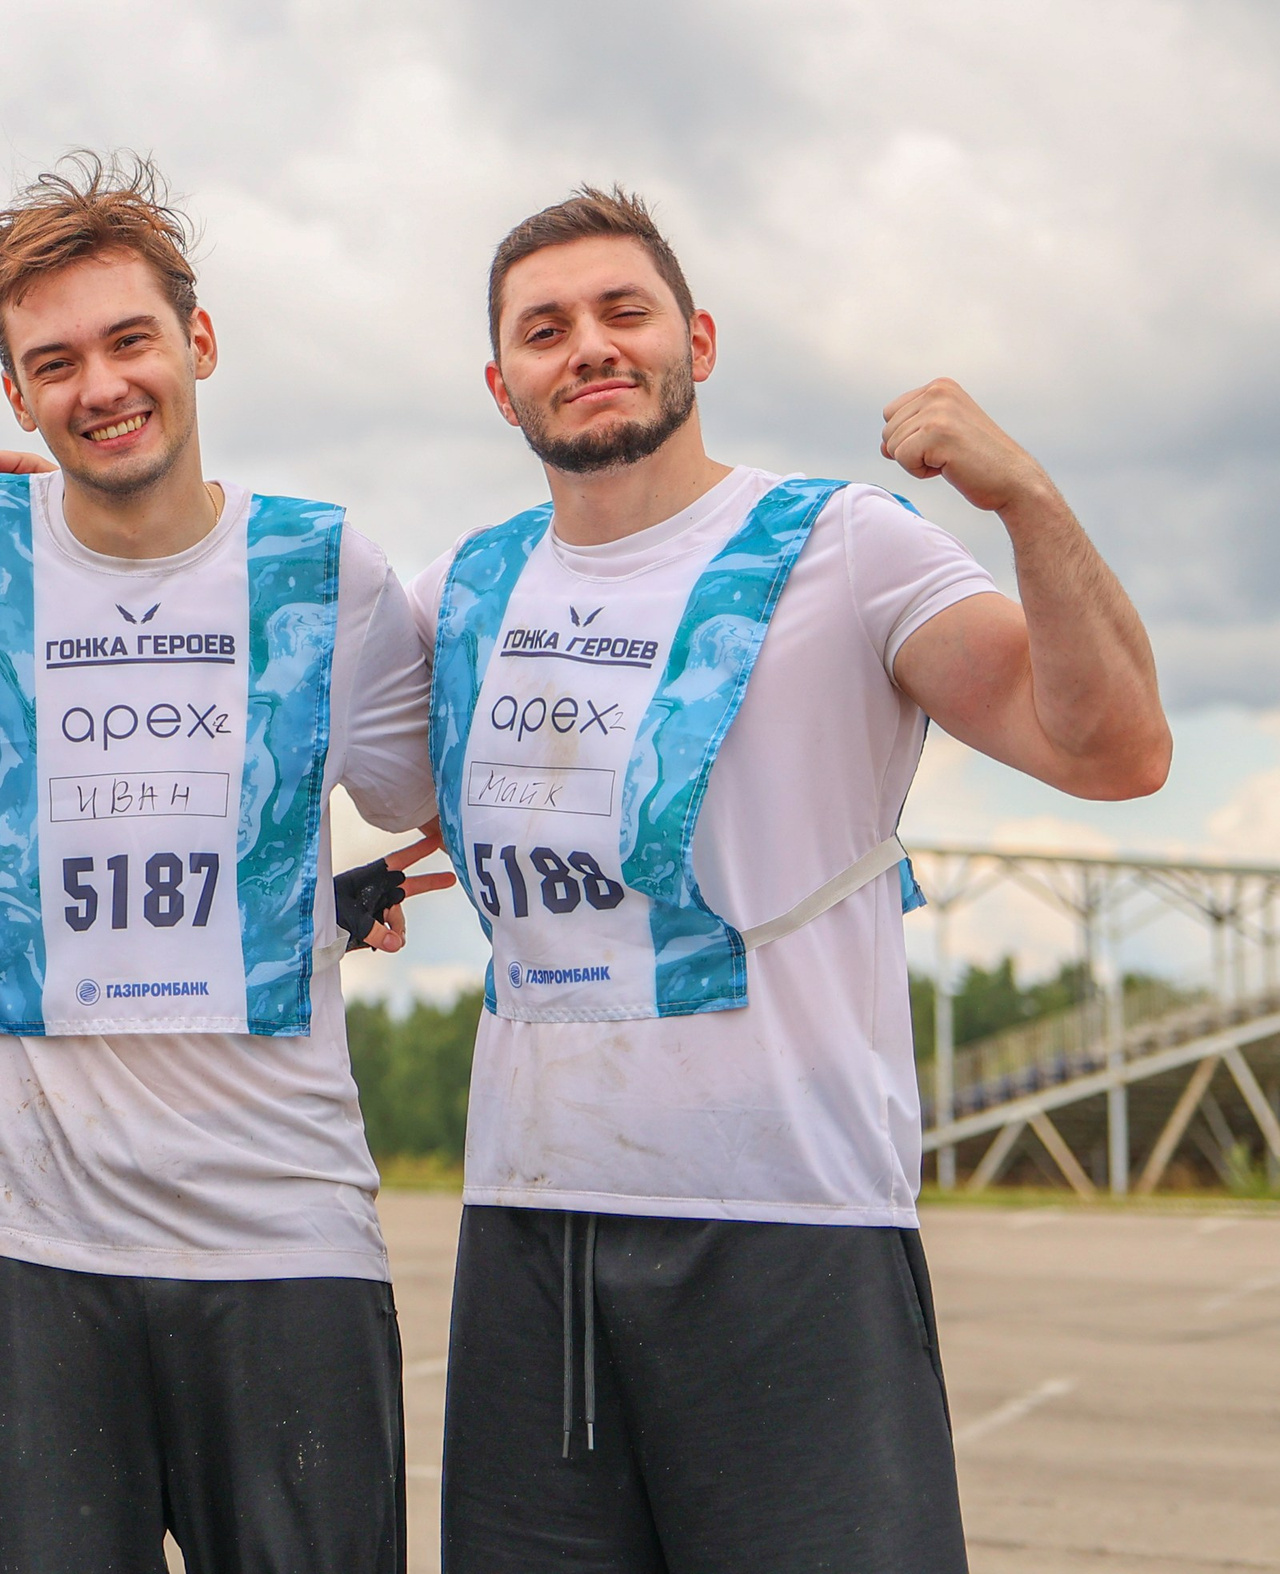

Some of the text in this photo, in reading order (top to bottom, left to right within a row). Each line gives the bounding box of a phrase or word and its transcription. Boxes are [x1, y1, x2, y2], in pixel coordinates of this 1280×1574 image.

[46, 634, 236, 661] ГОНКА ГЕРОЕВ
[503, 629, 659, 660] ГОНКА ГЕРОЕВ
[61, 703, 217, 751] apex
[491, 695, 619, 742] apex
[76, 778, 190, 819] ИВАН
[478, 770, 563, 807] Майк
[62, 852, 220, 932] 5187
[473, 843, 625, 918] 5188
[106, 981, 210, 999] ГАЗПРОМБАНК
[525, 966, 611, 985] ГАЗПРОМБАНК
